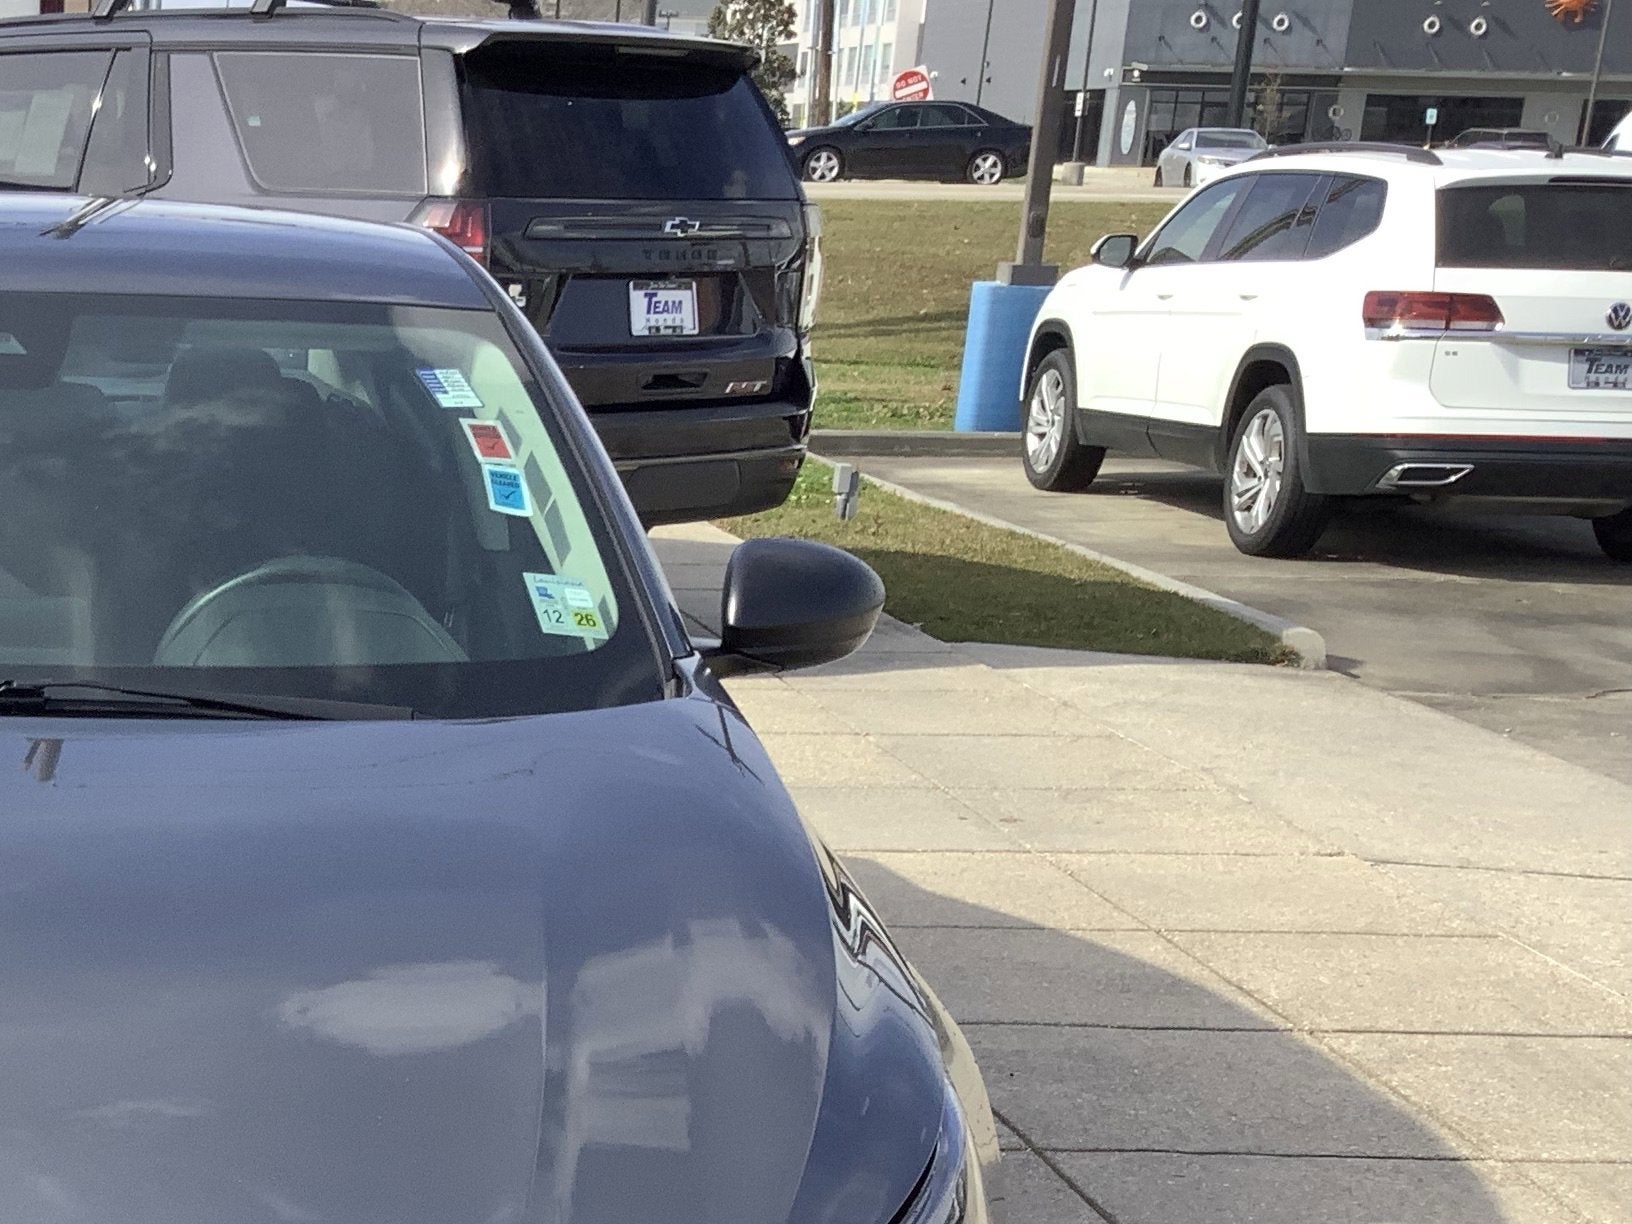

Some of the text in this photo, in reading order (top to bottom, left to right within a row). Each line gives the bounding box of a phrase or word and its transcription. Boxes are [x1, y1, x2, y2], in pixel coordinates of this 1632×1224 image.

[644, 292, 683, 315] TEAM
[1586, 357, 1630, 375] TEAM
[542, 608, 565, 624] 12
[574, 612, 597, 627] 26
